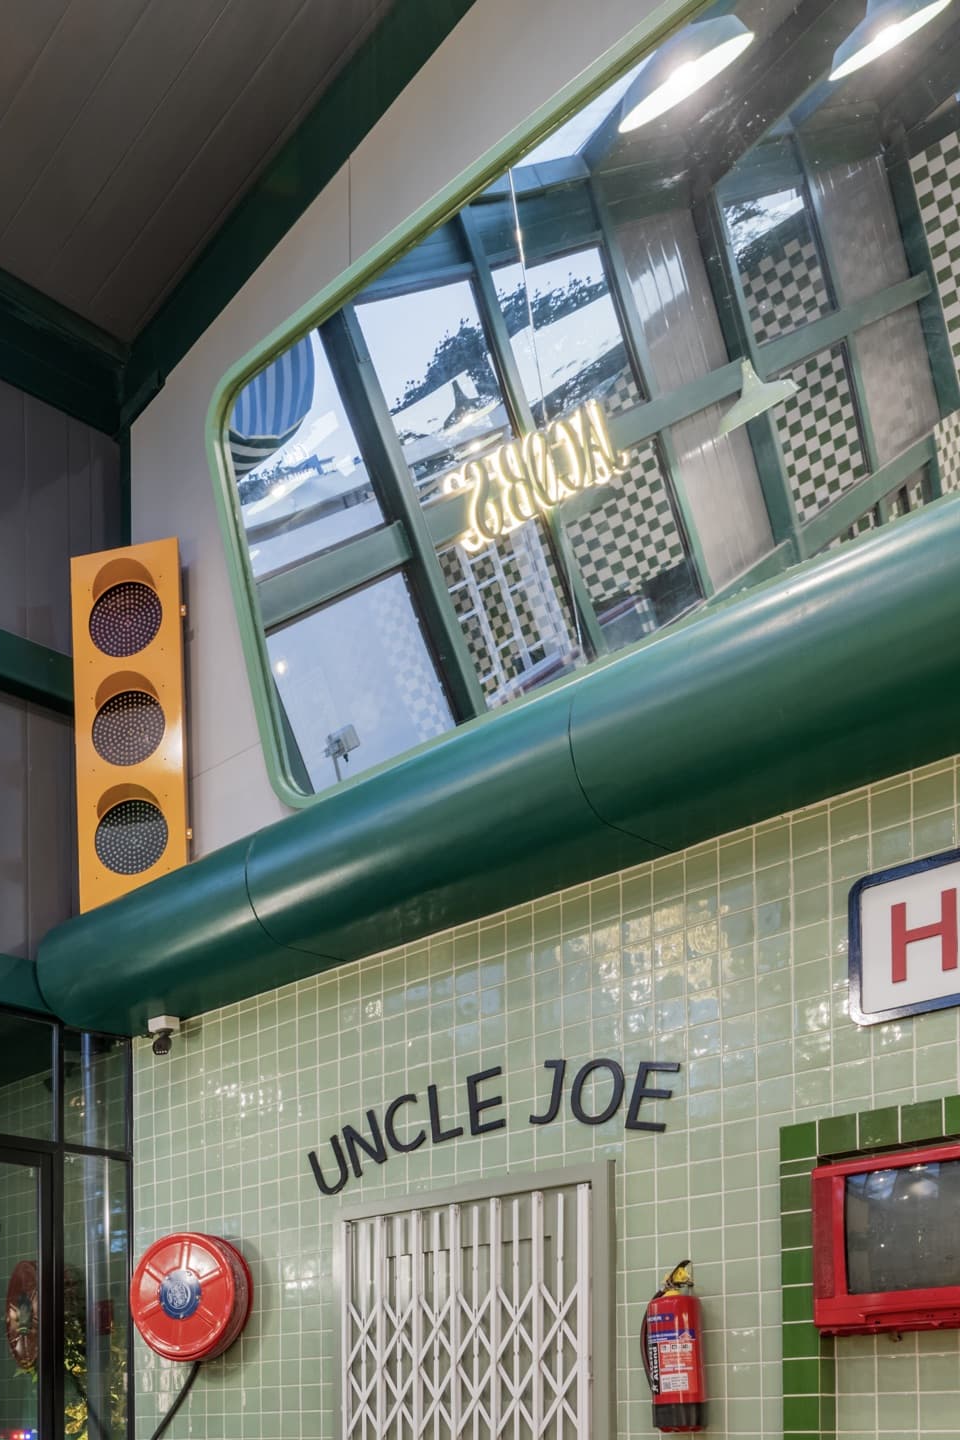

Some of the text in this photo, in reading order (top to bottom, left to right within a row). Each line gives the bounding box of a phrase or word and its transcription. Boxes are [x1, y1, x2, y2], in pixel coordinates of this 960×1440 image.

[890, 887, 958, 985] H
[307, 1058, 681, 1196] UNCLE JOE
